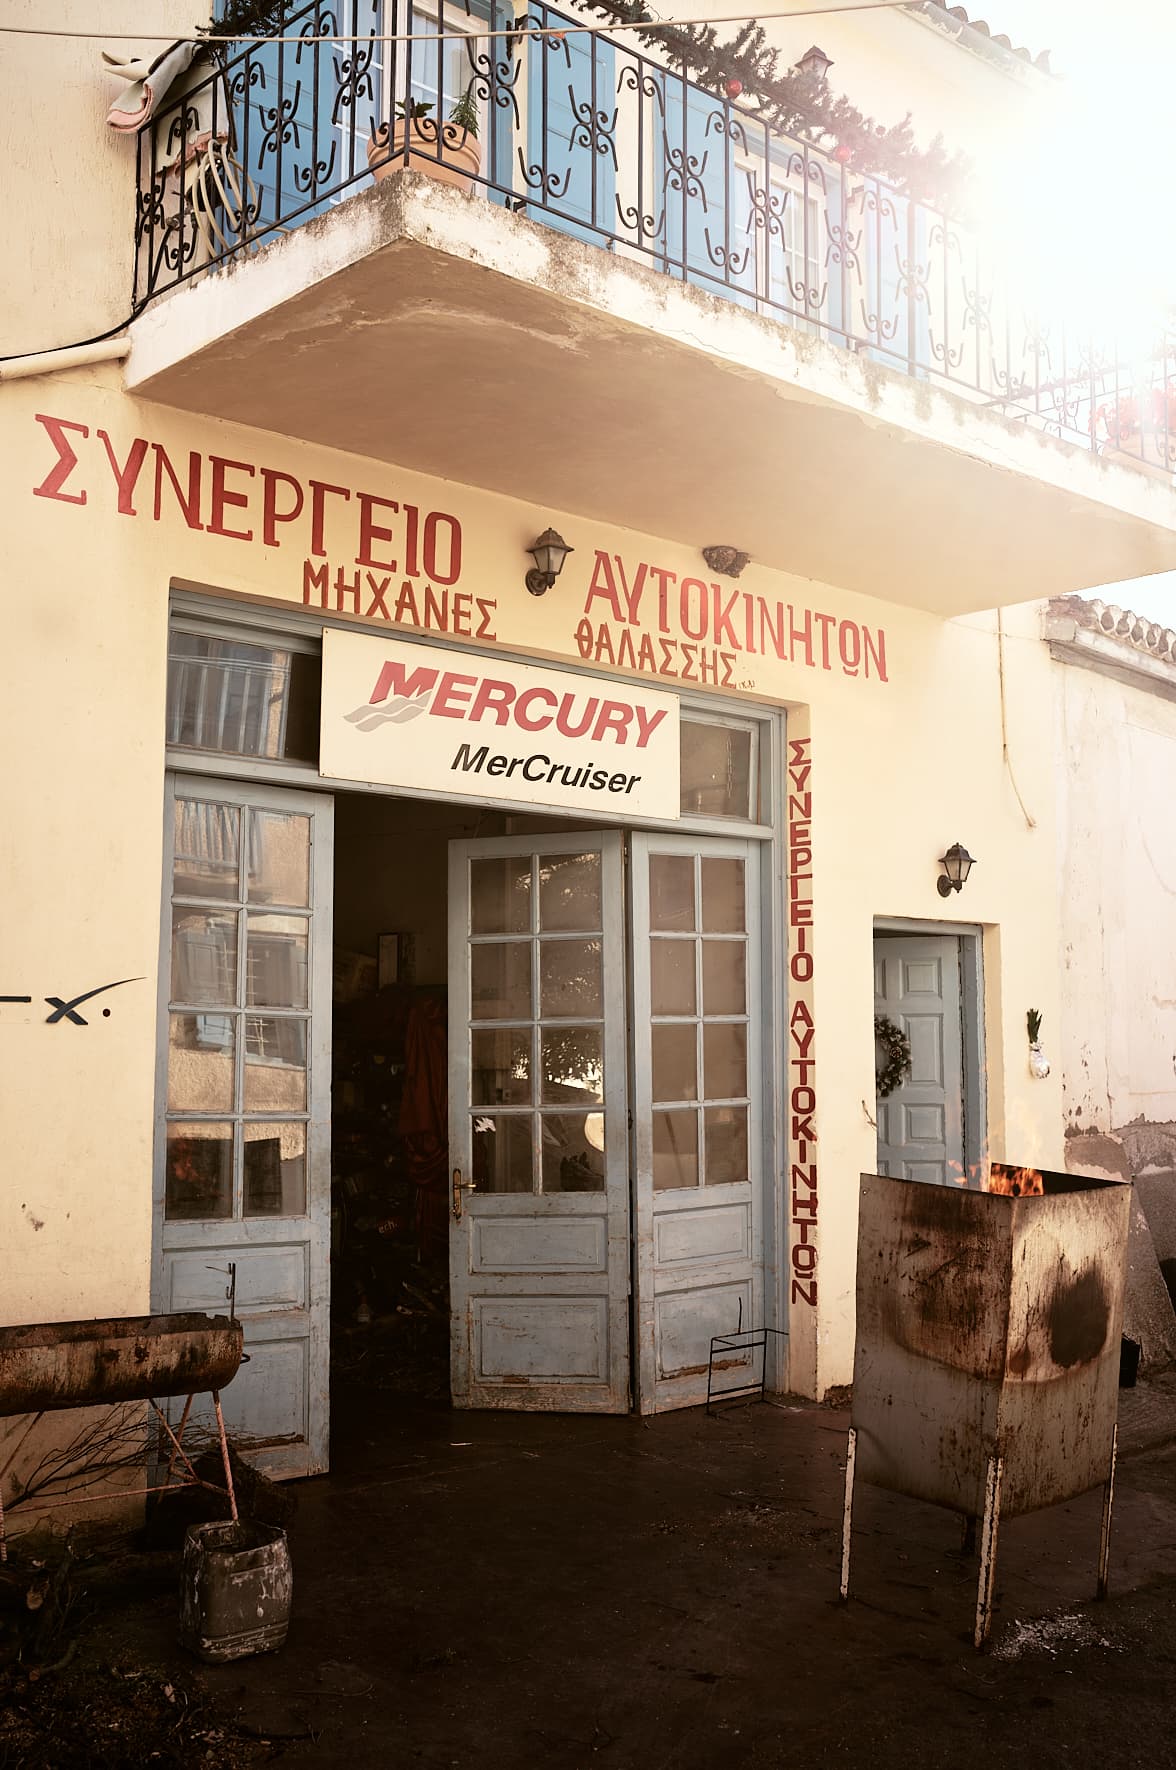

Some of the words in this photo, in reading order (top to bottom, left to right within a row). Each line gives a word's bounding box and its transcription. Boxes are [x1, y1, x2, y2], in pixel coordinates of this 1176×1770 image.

[33, 413, 463, 586] ΣΥΝΕΡΓΕΙΟ
[584, 550, 889, 682] ΑΥΤΟΚΙΝΗΤΩΝ
[303, 558, 497, 641] ΜΗΧΑΝΕΣ
[574, 617, 737, 689] ΘΑΛΑΣΣΗΣ
[369, 660, 668, 748] MERCURY
[450, 743, 642, 795] MerCruiser
[788, 738, 814, 982] ΣΥΝΕΡΓΕΙΟ
